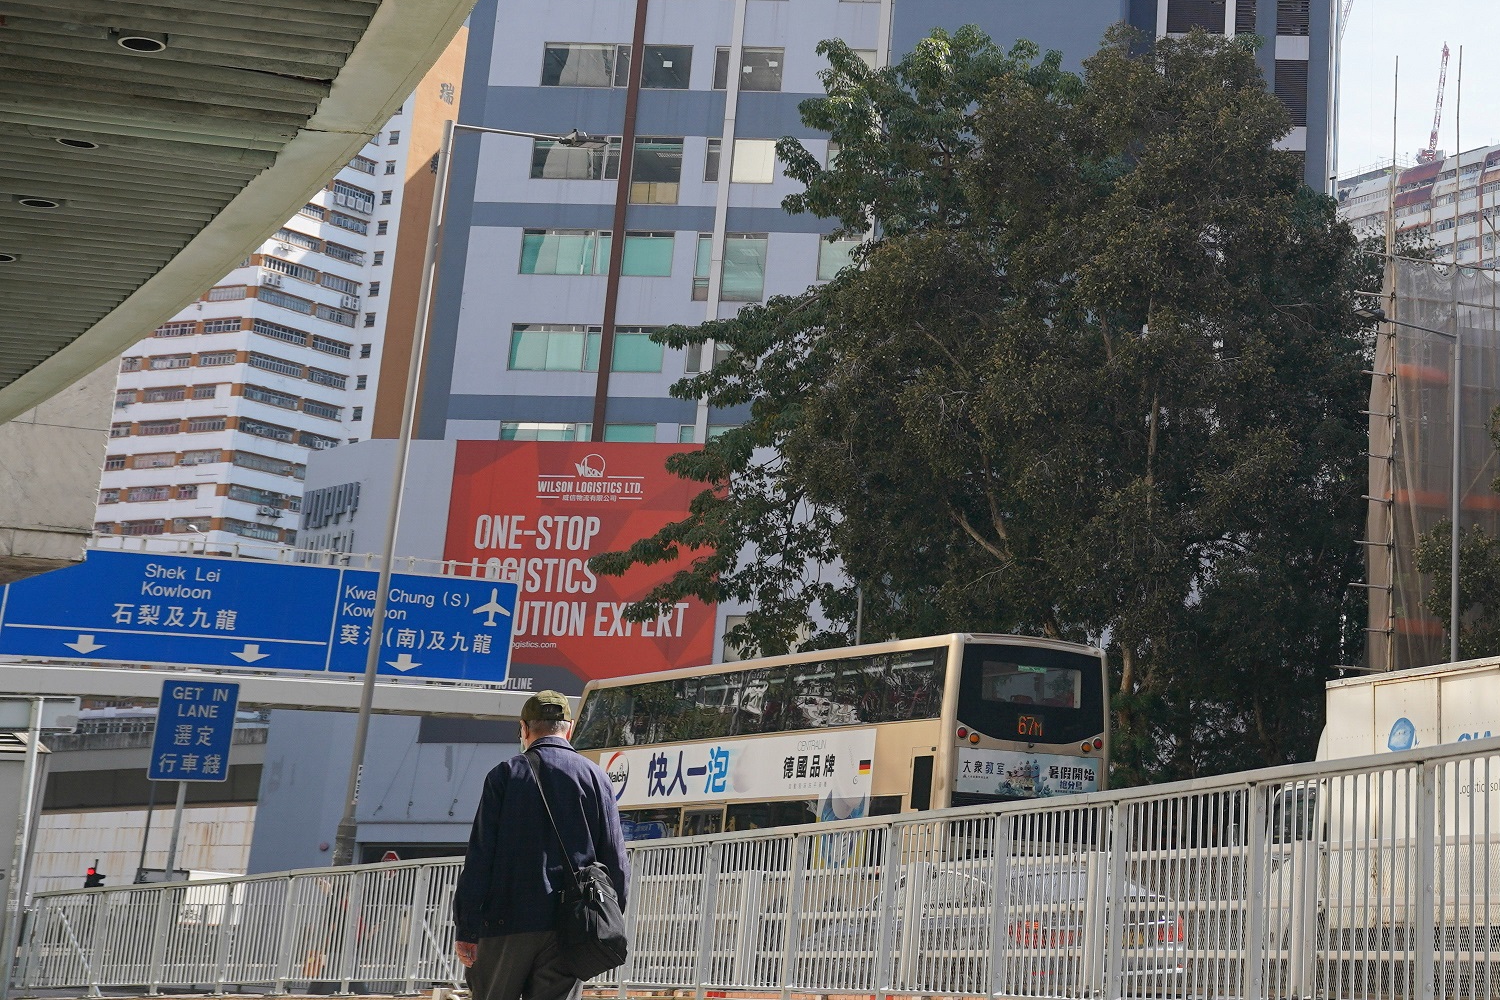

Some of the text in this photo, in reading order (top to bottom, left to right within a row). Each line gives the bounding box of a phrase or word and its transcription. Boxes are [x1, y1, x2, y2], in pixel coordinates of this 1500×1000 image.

[537, 480, 644, 494] WILSON LOGISTICS LTD.
[474, 514, 601, 550] ONE-STOP
[144, 563, 221, 582] Shek Lei
[140, 580, 212, 600] Kowloon
[345, 585, 470, 608] Kwa Chung (S)
[111, 602, 238, 632] 石梨及九龍
[342, 602, 406, 620] Kowon
[172, 686, 229, 702] GET IN
[177, 703, 219, 719] LANE
[173, 724, 214, 747] 選定
[1017, 715, 1044, 737] 67M
[647, 746, 730, 798] 快人一泡
[783, 753, 836, 780] 德國品牌
[1048, 765, 1095, 782] 暑假開始
